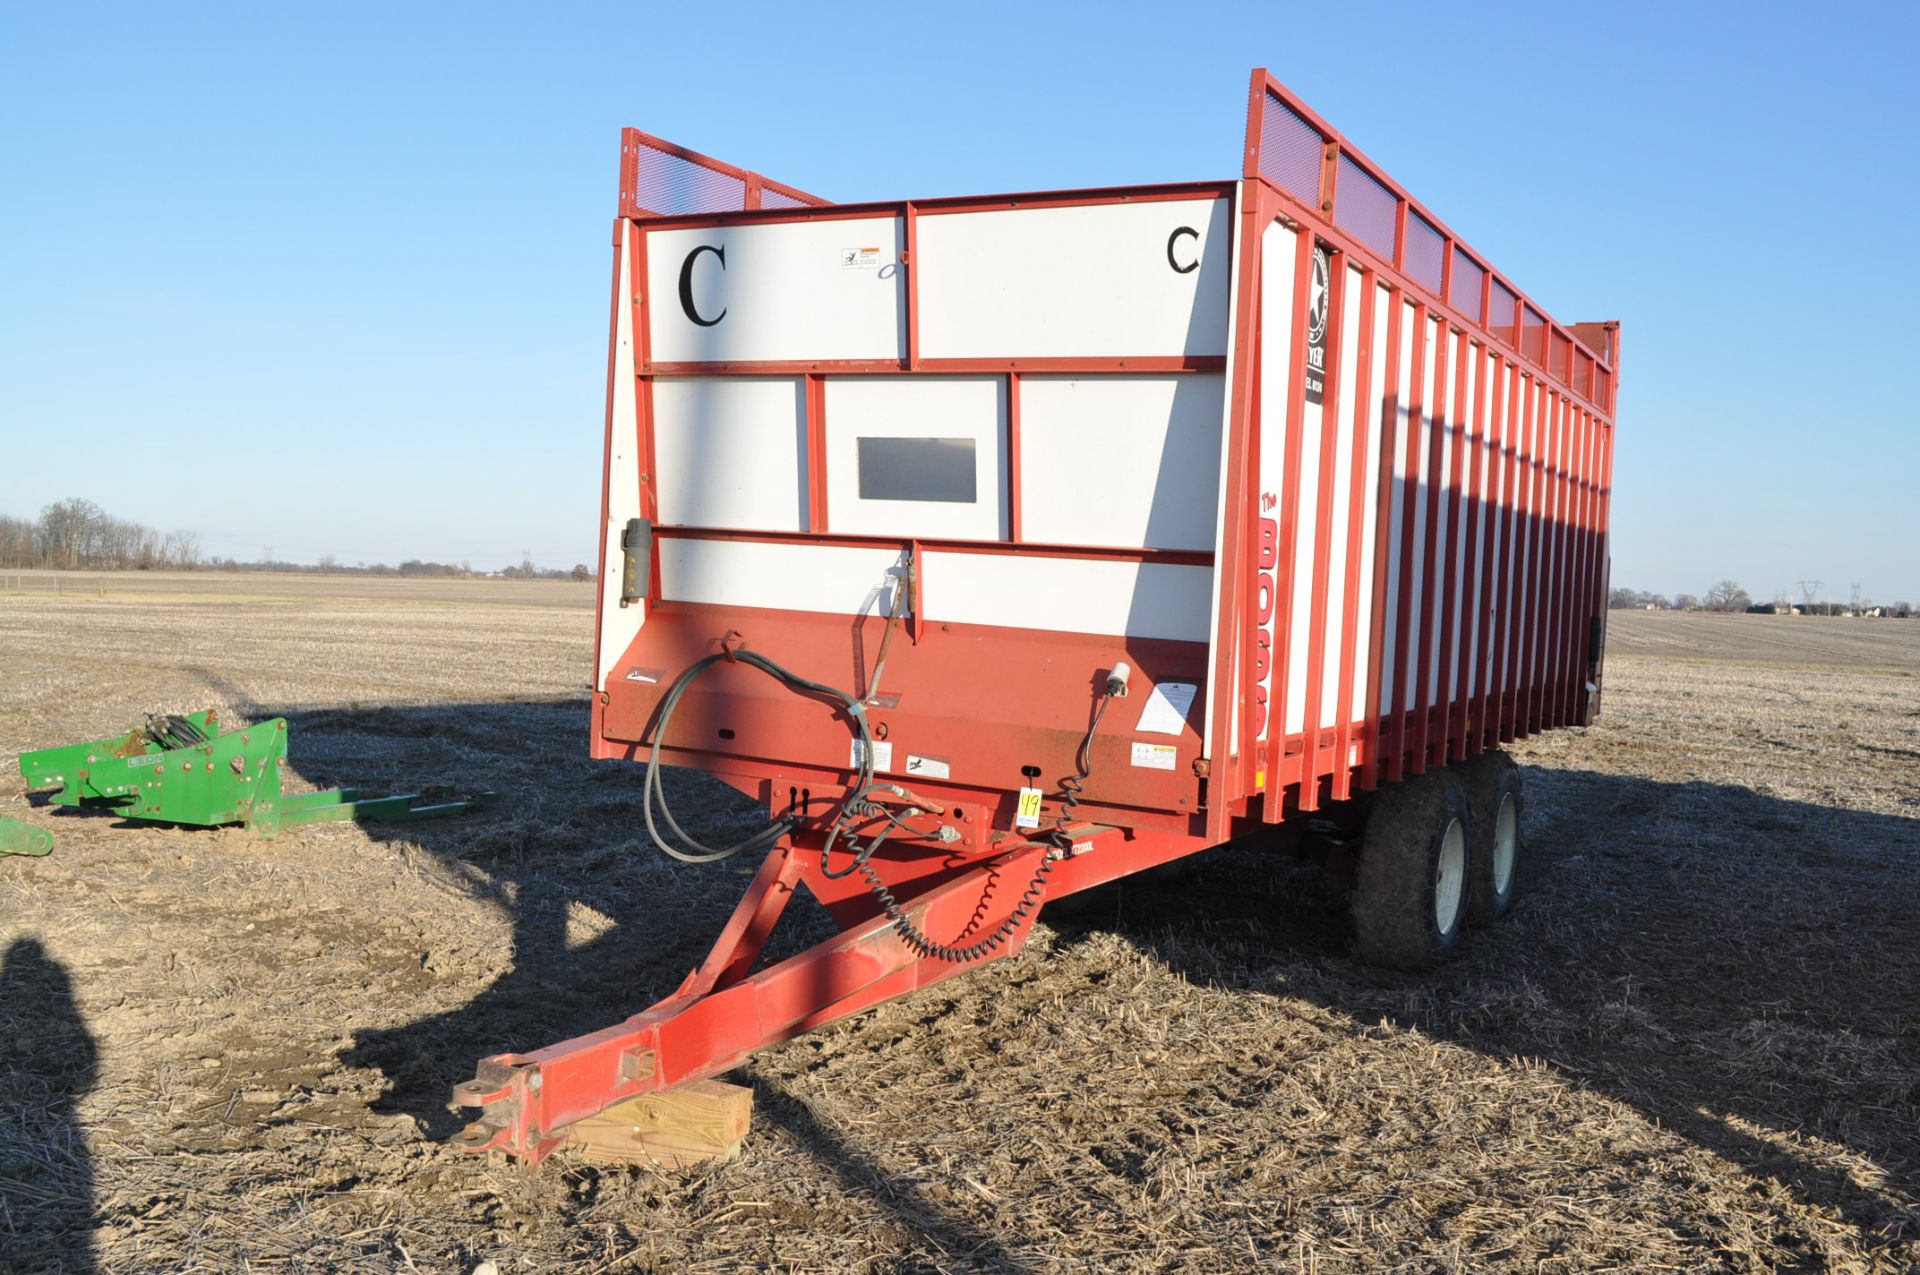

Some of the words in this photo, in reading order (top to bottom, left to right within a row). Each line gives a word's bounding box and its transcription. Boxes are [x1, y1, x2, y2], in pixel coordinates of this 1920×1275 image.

[1167, 225, 1200, 274] C
[678, 242, 727, 327] C
[1021, 793, 1039, 816] 49
